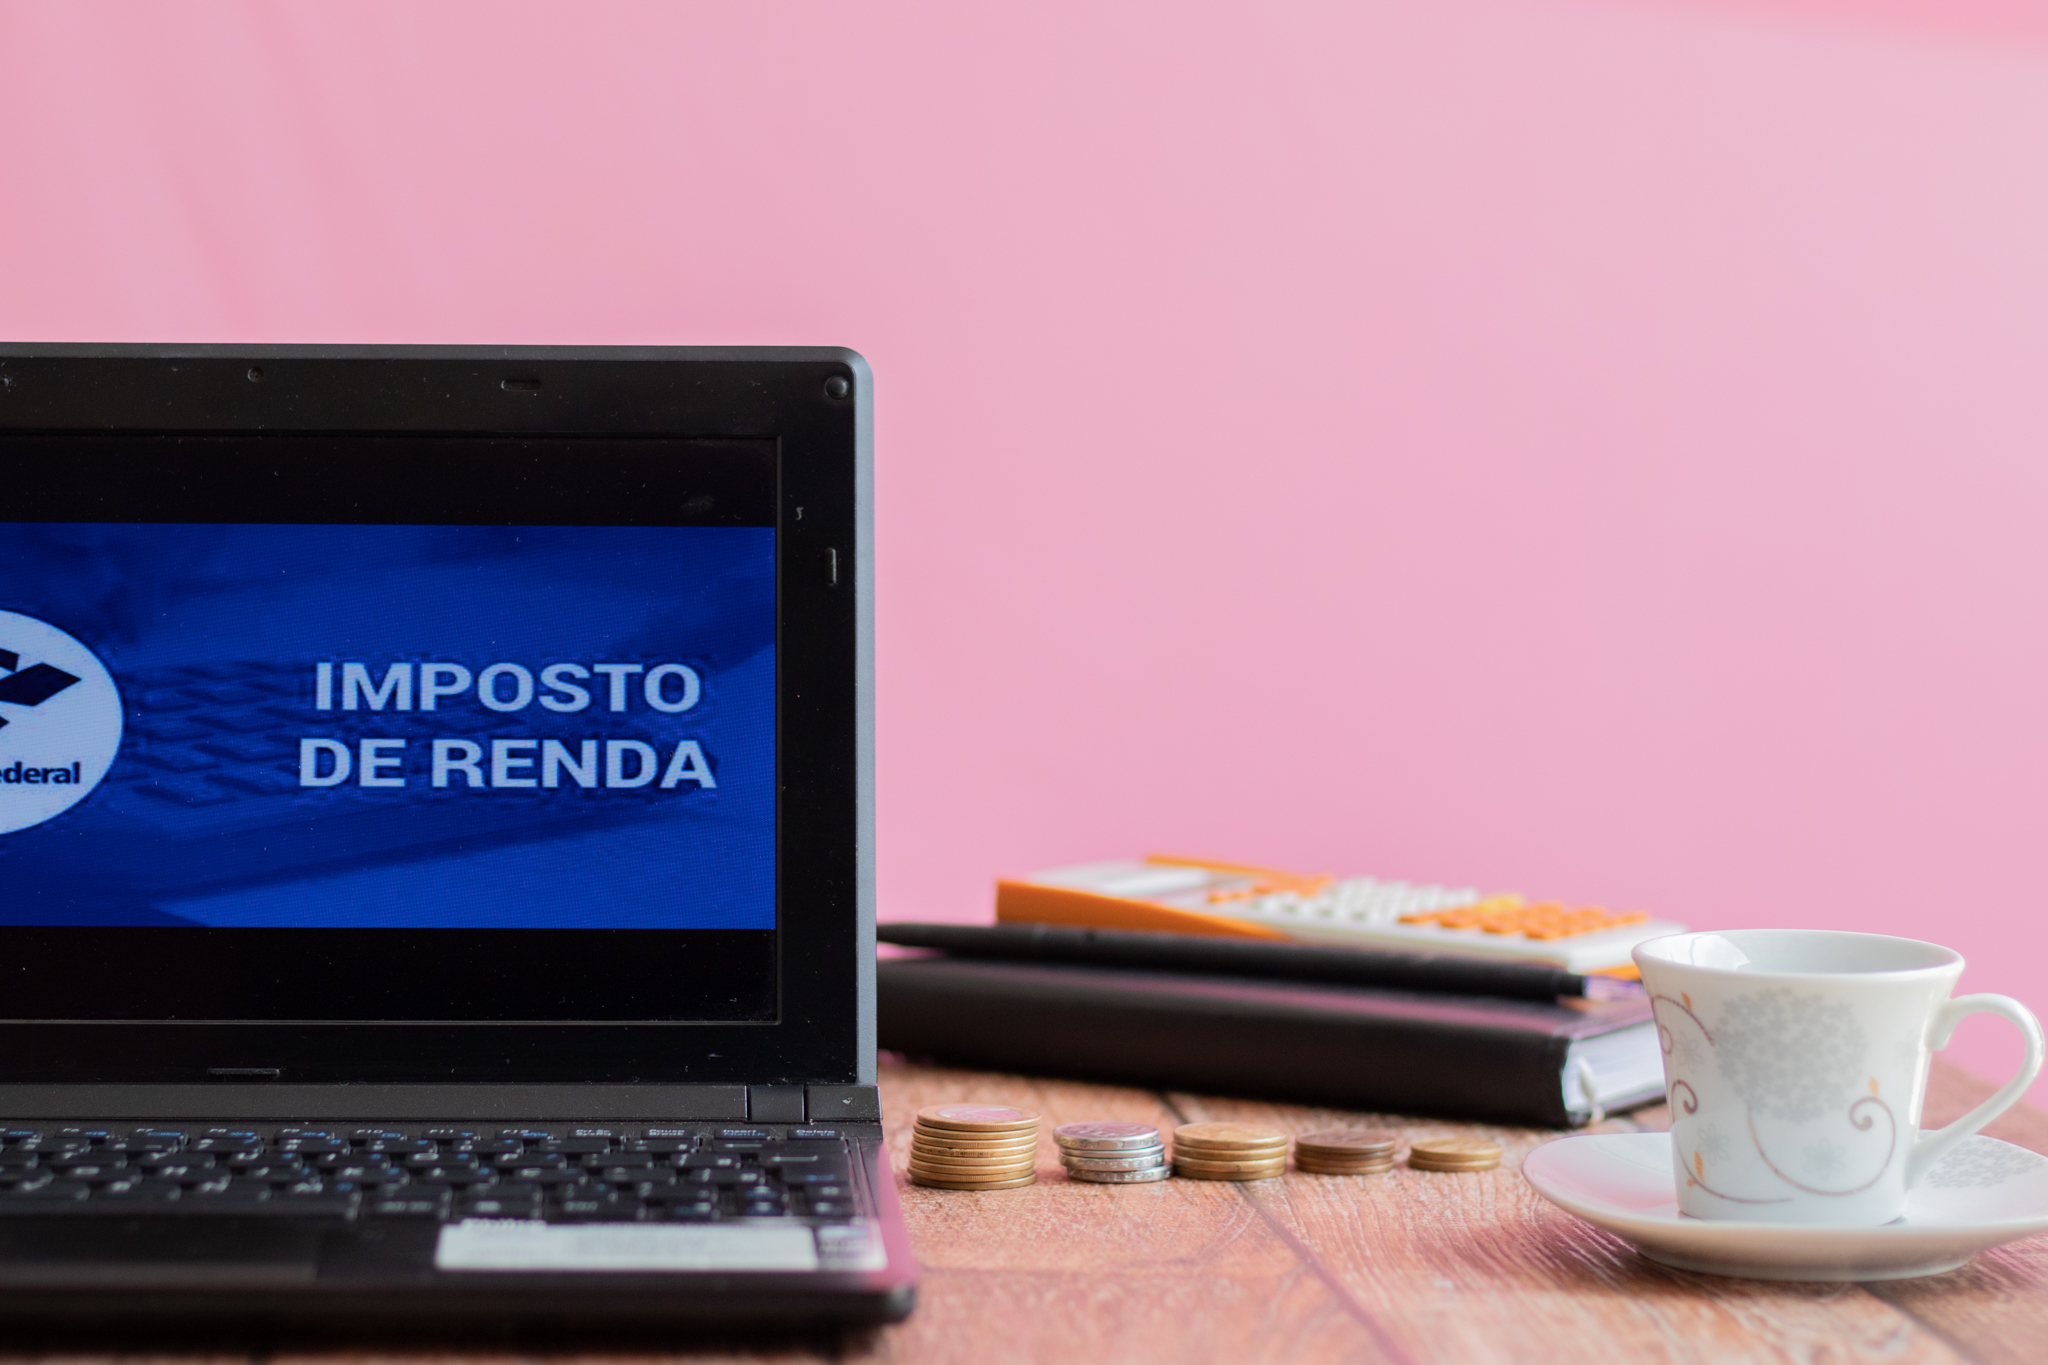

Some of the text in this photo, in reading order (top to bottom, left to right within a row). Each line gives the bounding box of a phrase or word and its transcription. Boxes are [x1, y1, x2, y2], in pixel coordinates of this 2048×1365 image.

[316, 662, 701, 712] IMPOSTO
[0, 761, 80, 784] deral
[299, 740, 717, 787] DE RENDA
